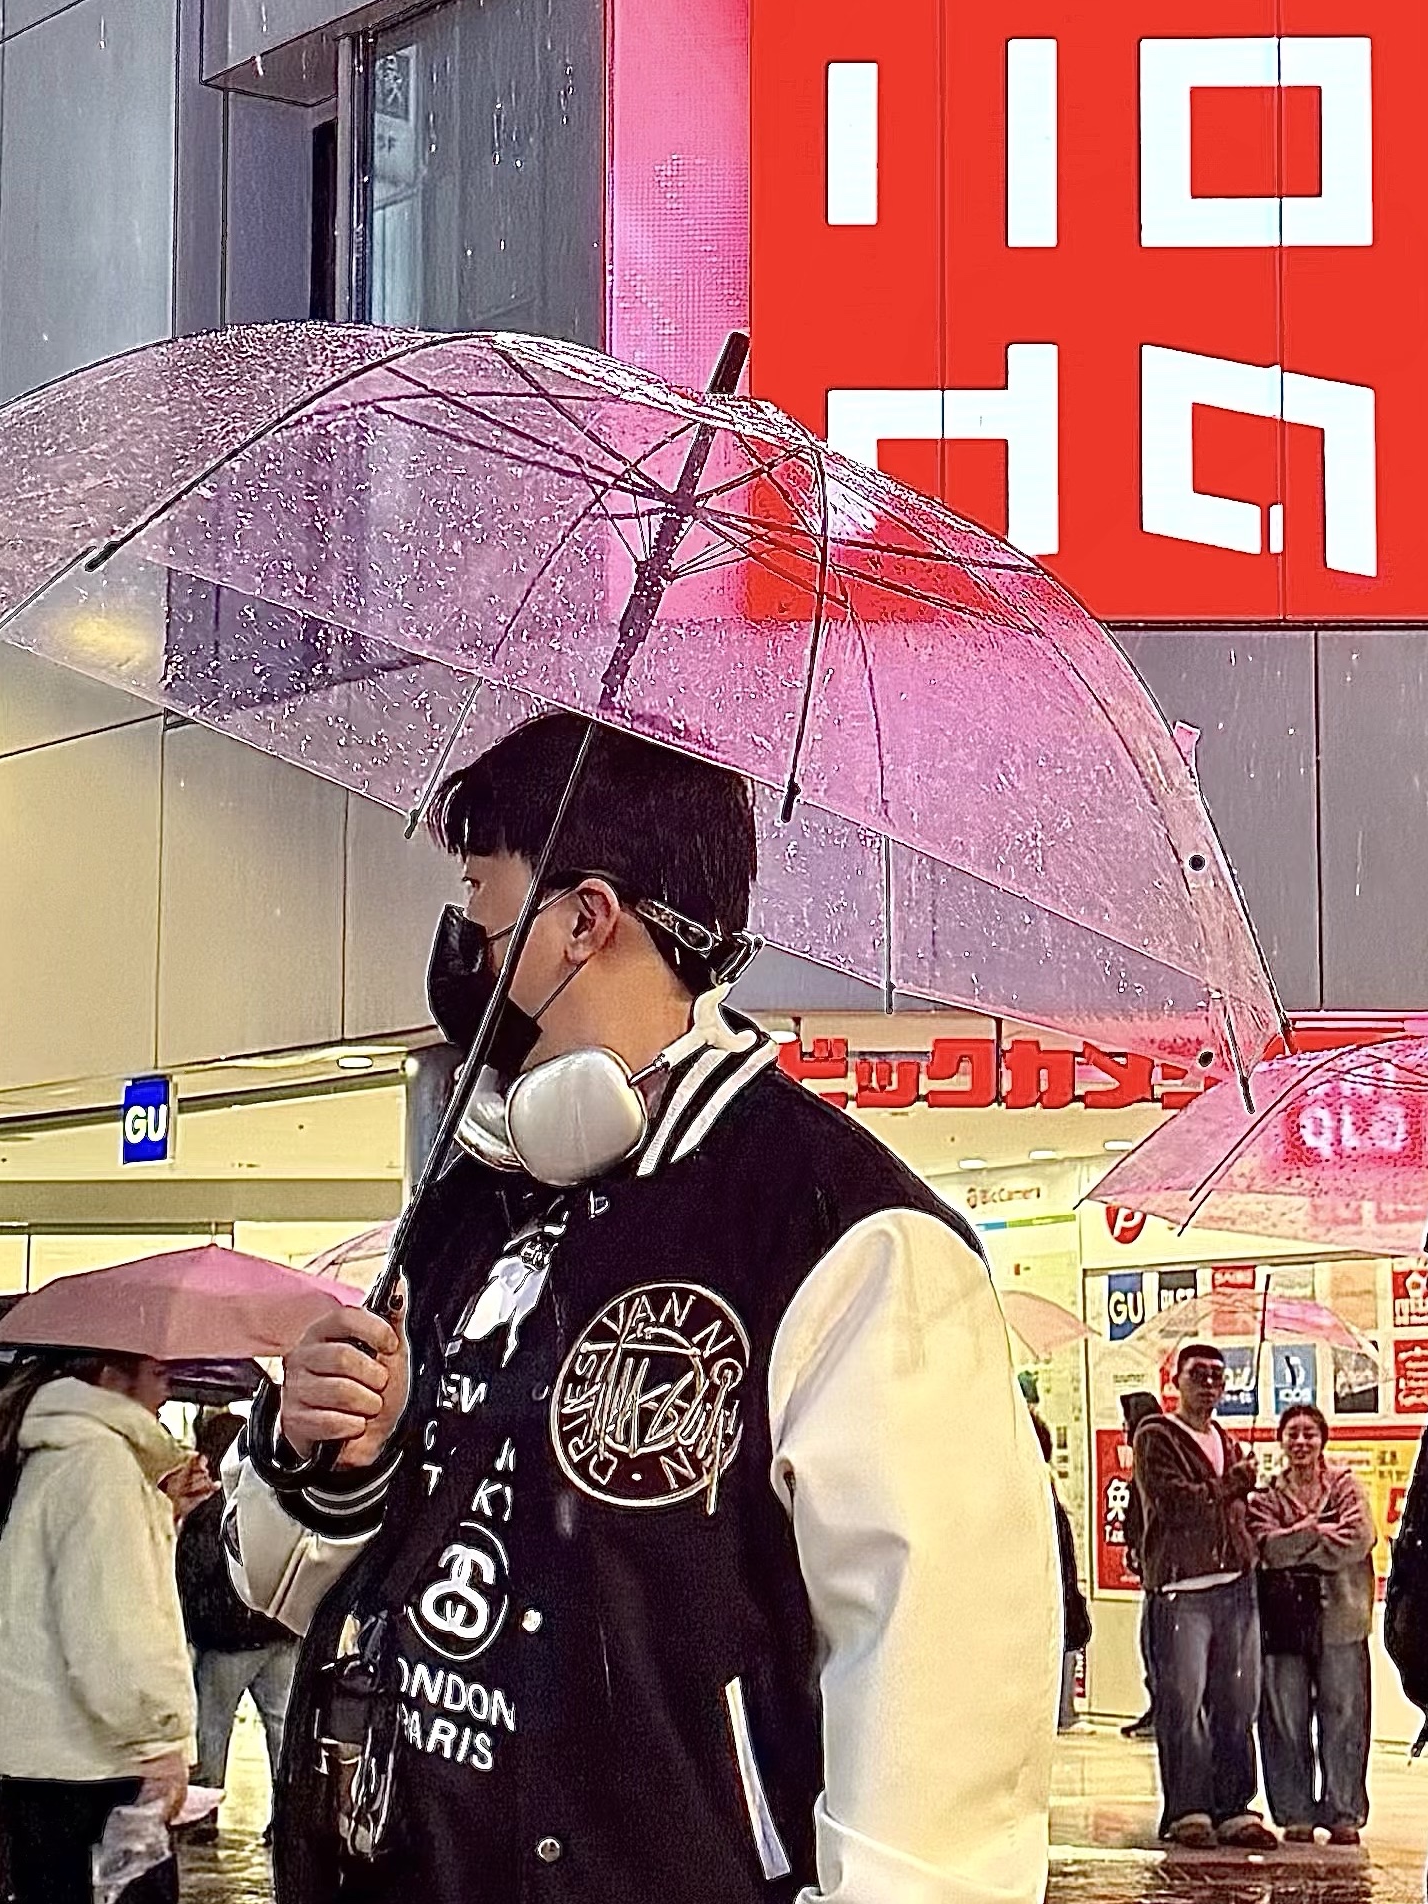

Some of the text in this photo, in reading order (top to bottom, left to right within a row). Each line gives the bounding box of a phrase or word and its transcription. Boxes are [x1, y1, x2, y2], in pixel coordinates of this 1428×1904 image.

[124, 1104, 168, 1144] GU
[601, 1291, 697, 1336] VAN
[1108, 1291, 1145, 1325] GU
